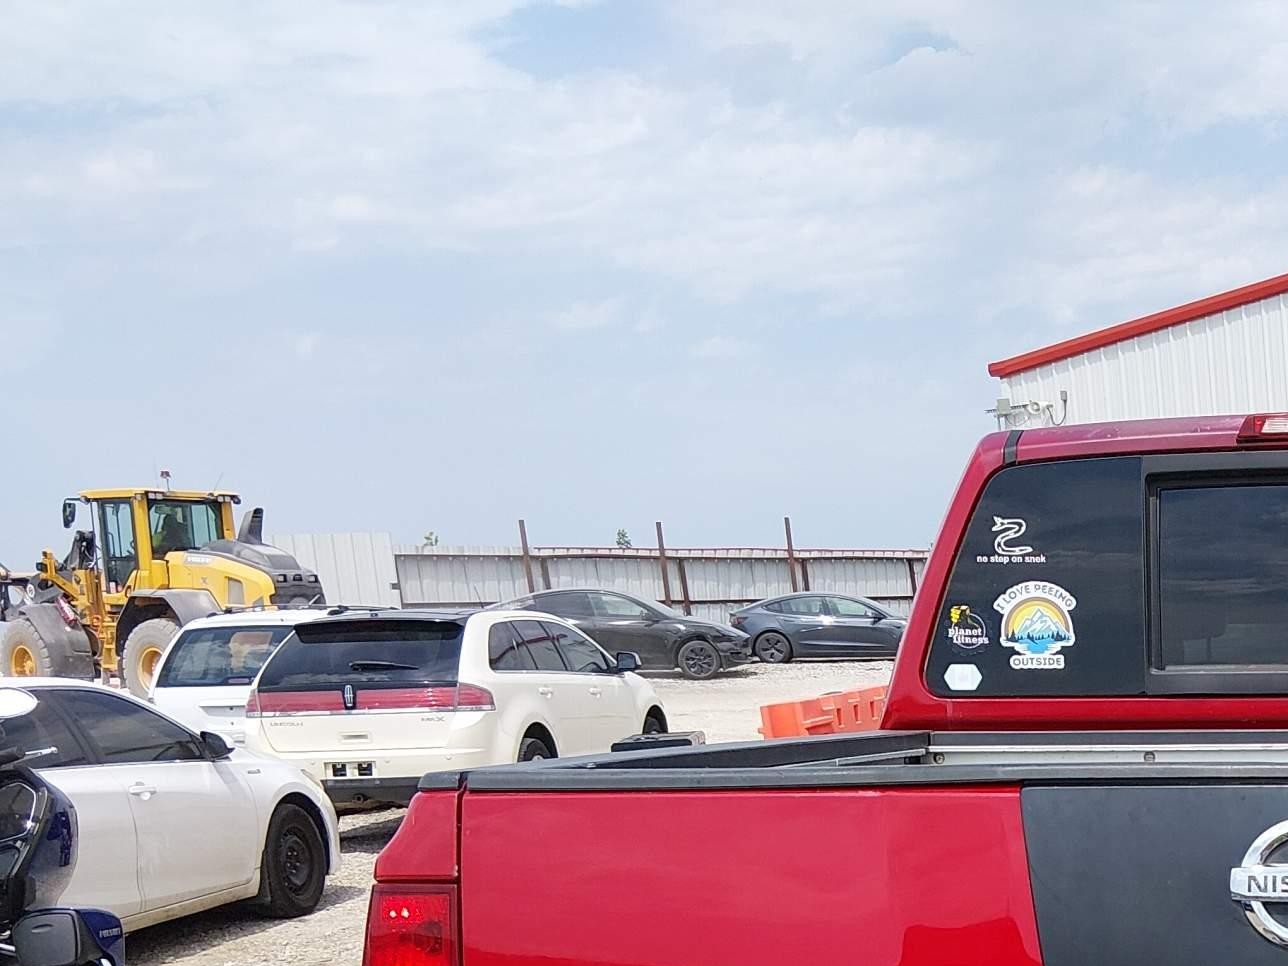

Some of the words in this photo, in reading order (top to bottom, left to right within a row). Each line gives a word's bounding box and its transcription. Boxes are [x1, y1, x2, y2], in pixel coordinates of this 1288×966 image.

[976, 555, 988, 563] no
[1011, 555, 1023, 563] on
[997, 603, 1005, 611] I
[1003, 585, 1032, 603] LOVE
[1034, 584, 1073, 608] PEEING
[948, 627, 982, 638] planet
[1012, 657, 1063, 667] OUTSIDE
